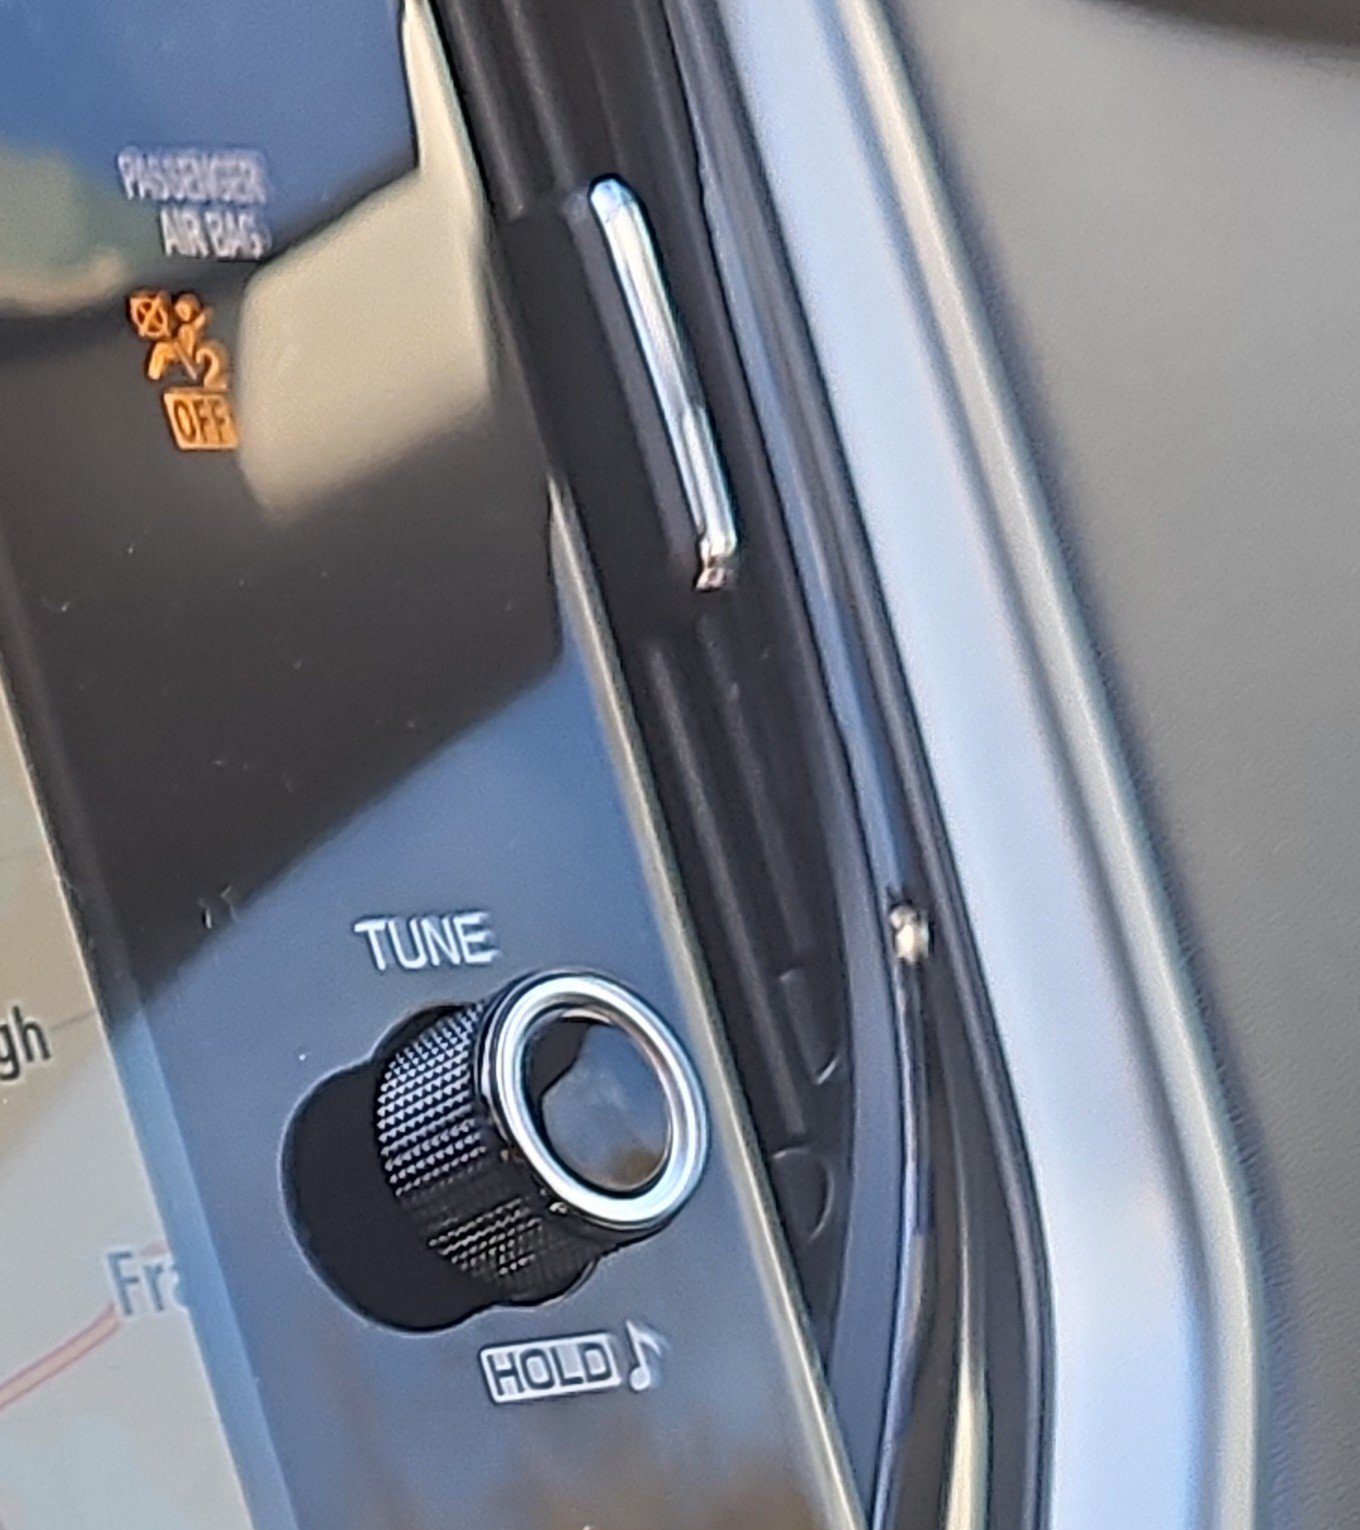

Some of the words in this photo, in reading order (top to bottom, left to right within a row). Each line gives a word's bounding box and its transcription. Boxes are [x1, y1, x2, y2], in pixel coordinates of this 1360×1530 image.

[117, 150, 267, 203] PASSENGER
[160, 207, 210, 258] AIR
[203, 211, 272, 260] BAG
[172, 398, 235, 444] OFF
[354, 910, 500, 971] TUNE
[106, 1250, 180, 1315] Fr
[490, 1339, 612, 1397] HOLD
